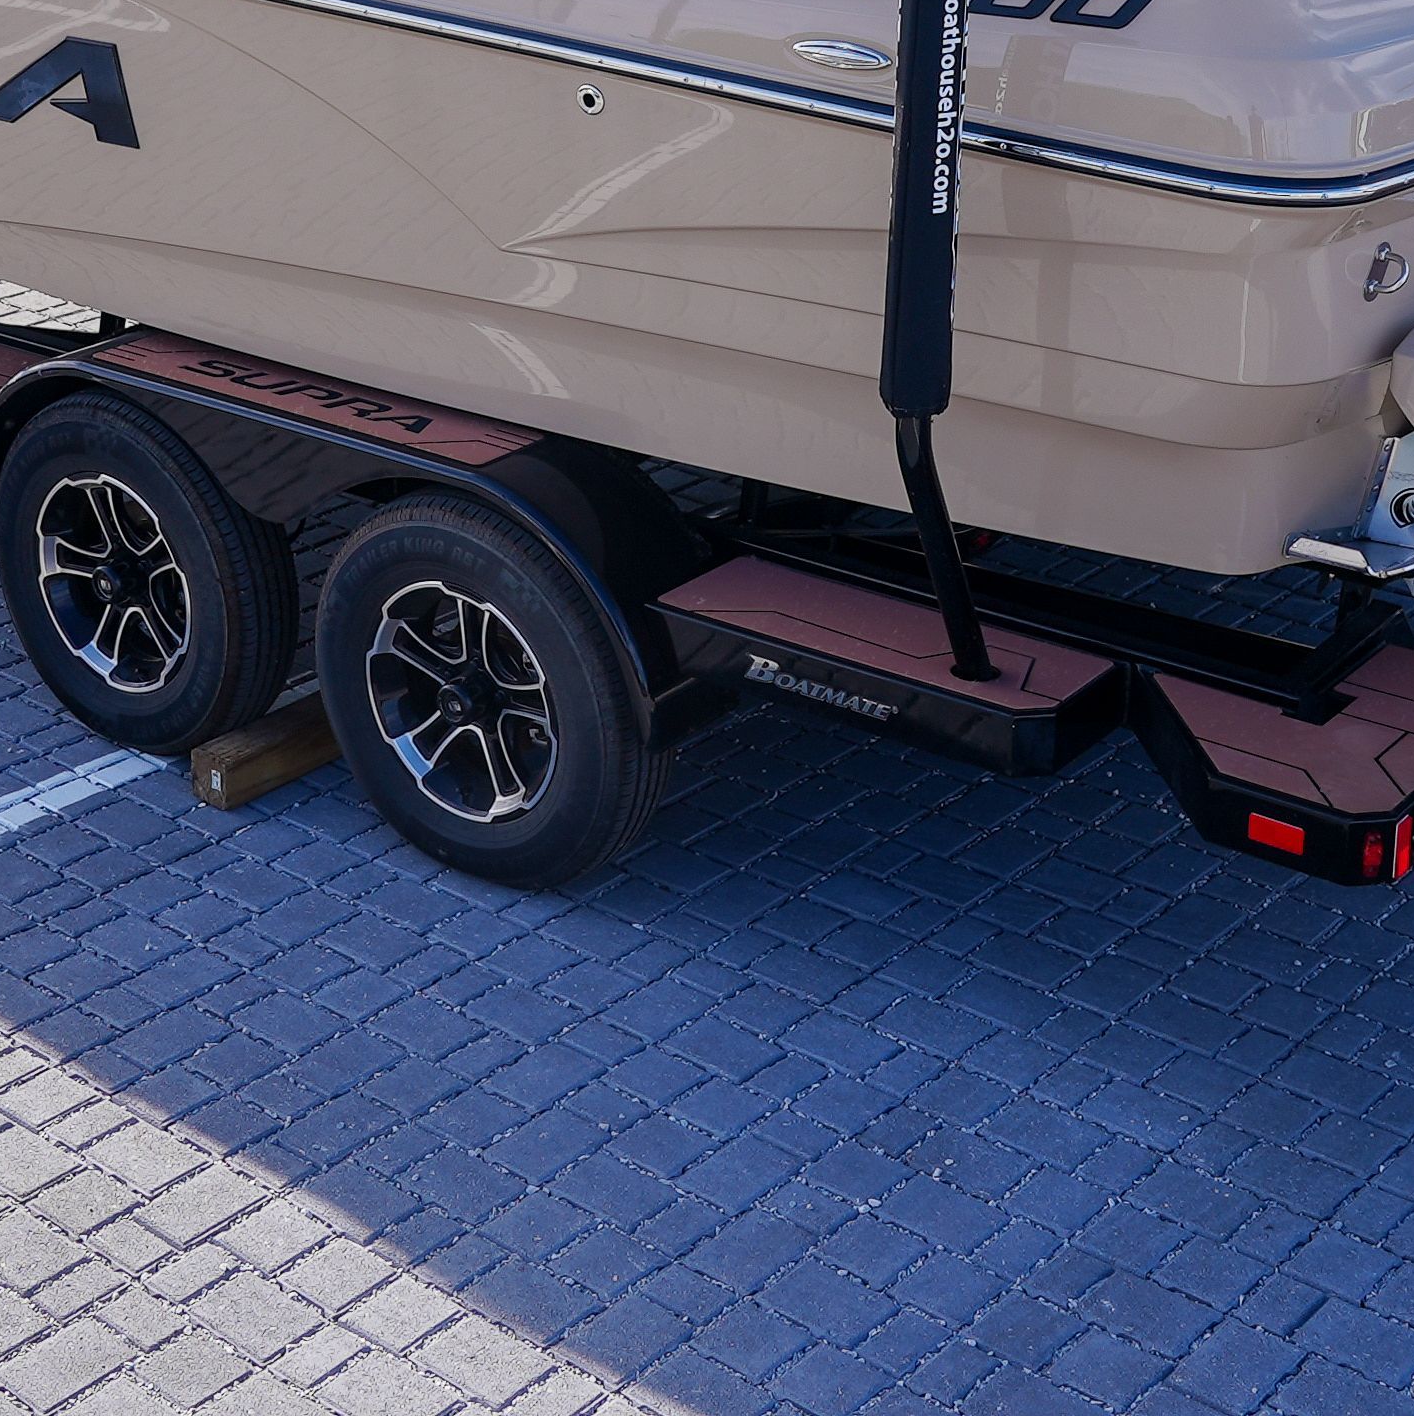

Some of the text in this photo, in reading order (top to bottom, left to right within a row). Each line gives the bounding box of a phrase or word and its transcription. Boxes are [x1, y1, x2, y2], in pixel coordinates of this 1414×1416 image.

[181, 357, 438, 434] SUPRA
[344, 539, 398, 584] TRAILER
[403, 536, 446, 555] KING
[743, 651, 894, 722] BOATMATE
